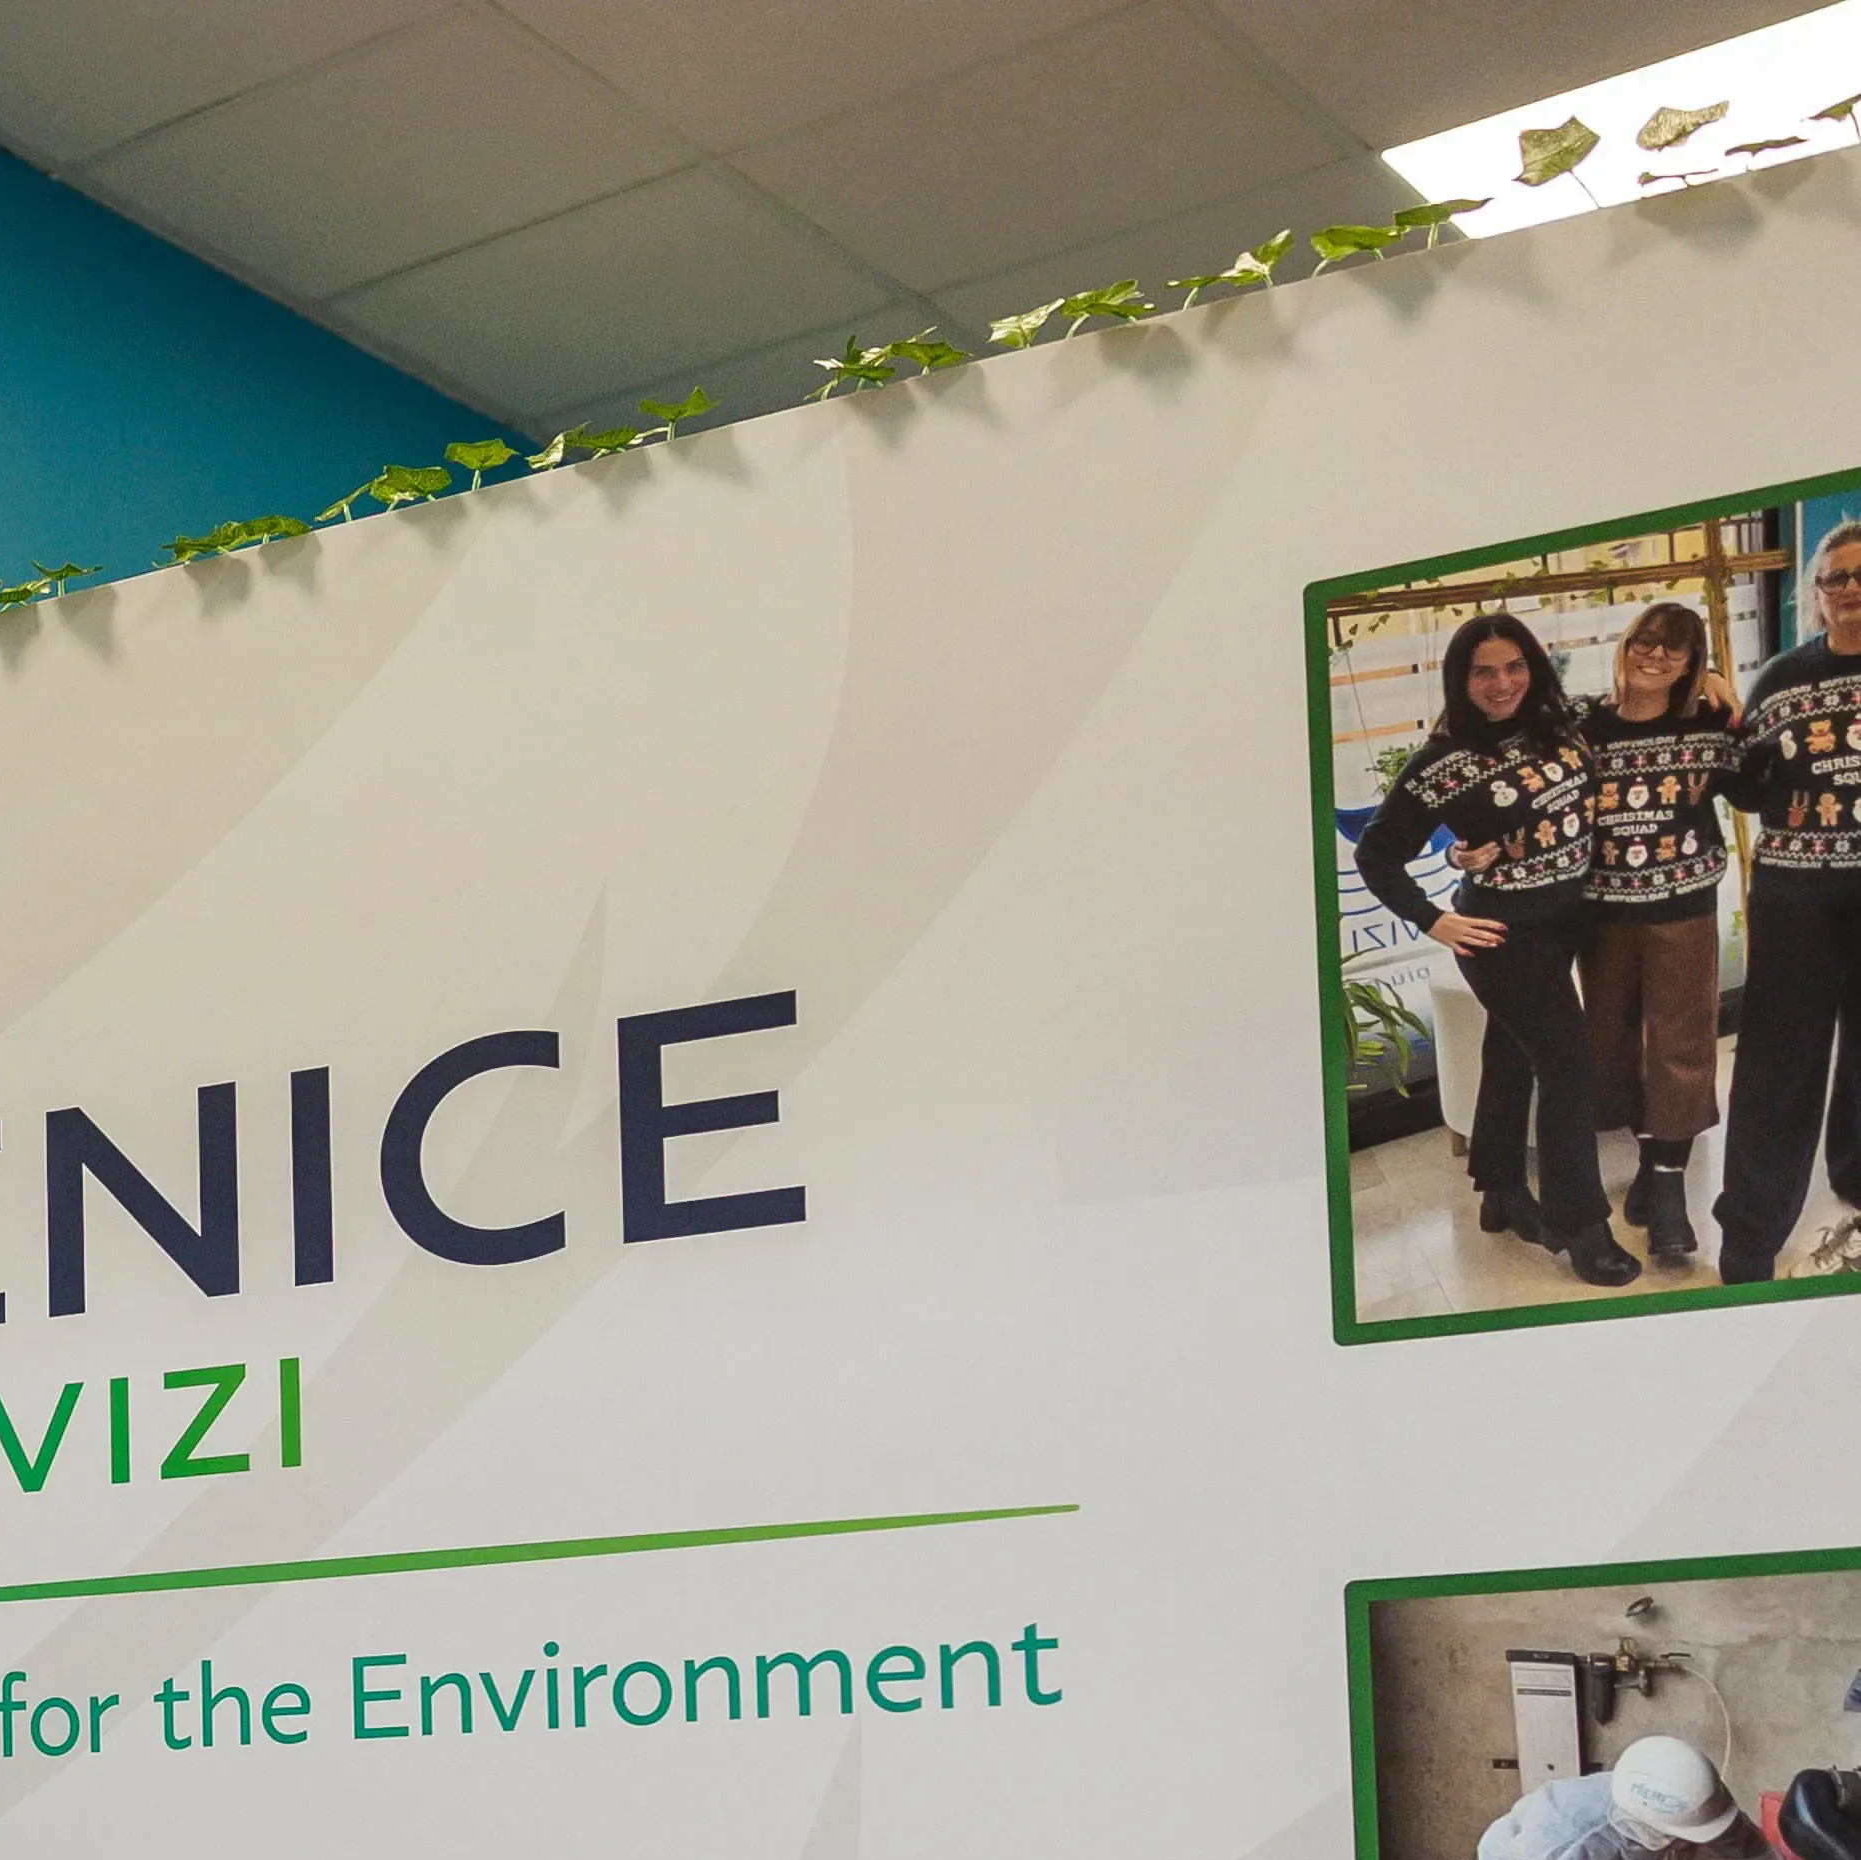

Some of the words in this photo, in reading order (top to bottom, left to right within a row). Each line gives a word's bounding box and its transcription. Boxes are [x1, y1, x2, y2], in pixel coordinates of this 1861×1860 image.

[1811, 755, 1861, 775] CHRIS
[1597, 810, 1675, 826] CHRISTMAS
[1612, 823, 1658, 837] SQUAD
[153, 1660, 312, 1750] the
[351, 1624, 1063, 1740] Environment
